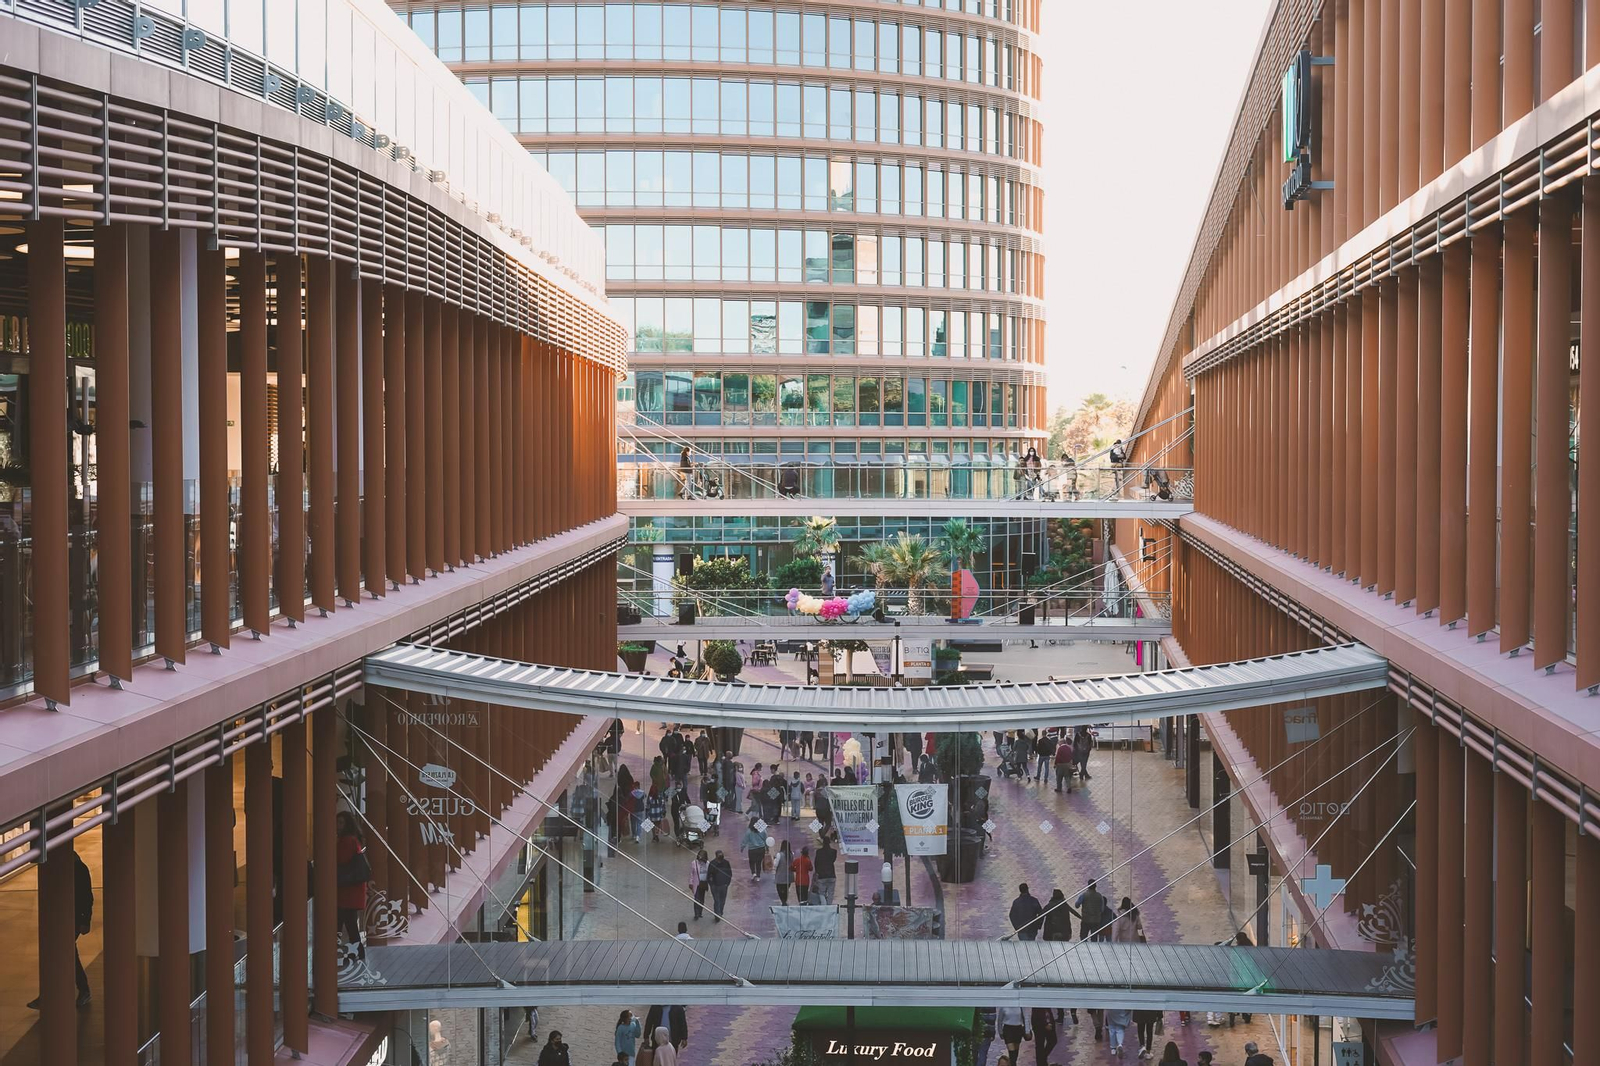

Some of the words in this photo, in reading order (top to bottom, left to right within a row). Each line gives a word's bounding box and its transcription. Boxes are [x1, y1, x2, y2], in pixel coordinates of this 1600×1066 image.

[858, 799, 866, 811] DE
[866, 799, 874, 811] LA
[909, 794, 933, 806] BURGER
[910, 800, 934, 813] KING
[844, 812, 874, 823] MODERNA
[890, 1042, 937, 1058] Food
